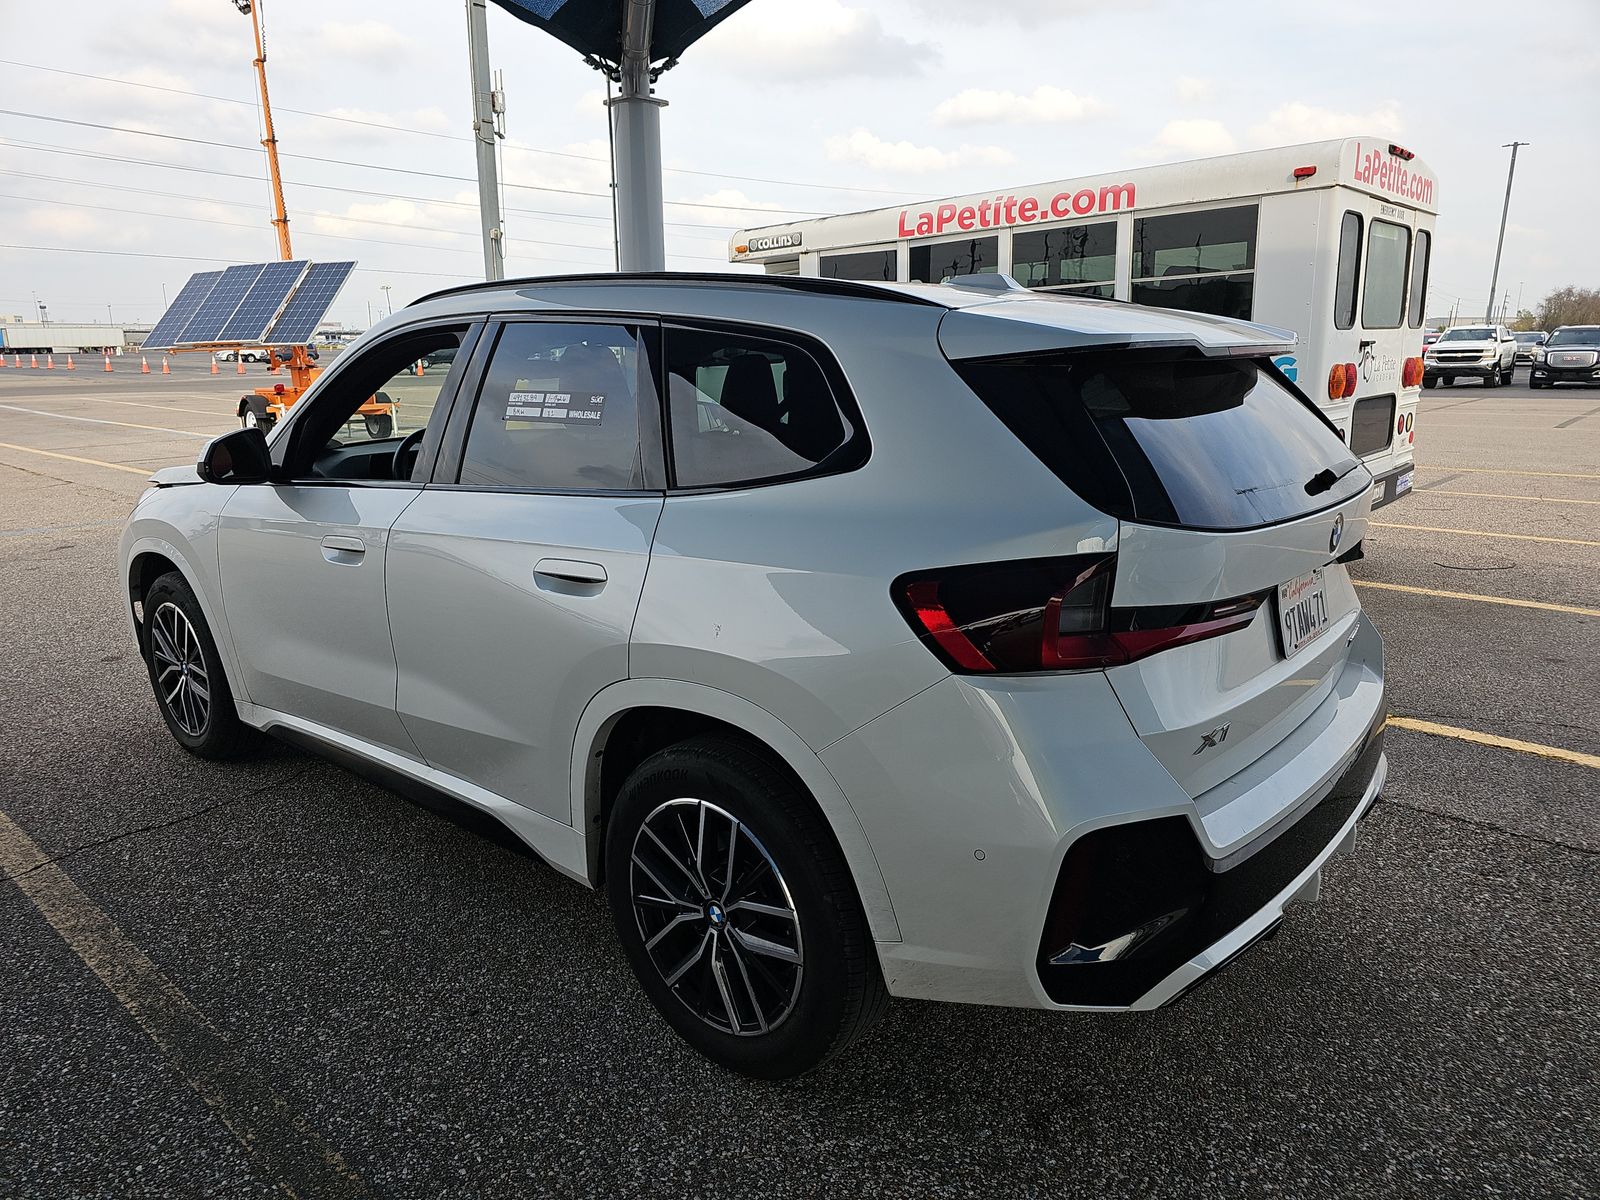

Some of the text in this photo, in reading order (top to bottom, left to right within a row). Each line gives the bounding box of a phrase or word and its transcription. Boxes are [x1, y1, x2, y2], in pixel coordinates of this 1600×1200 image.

[1354, 142, 1433, 205] LaPetite.com
[898, 182, 1136, 238] LaPetite.com
[568, 410, 601, 419] WHOLESALE
[1192, 720, 1231, 756] X1
